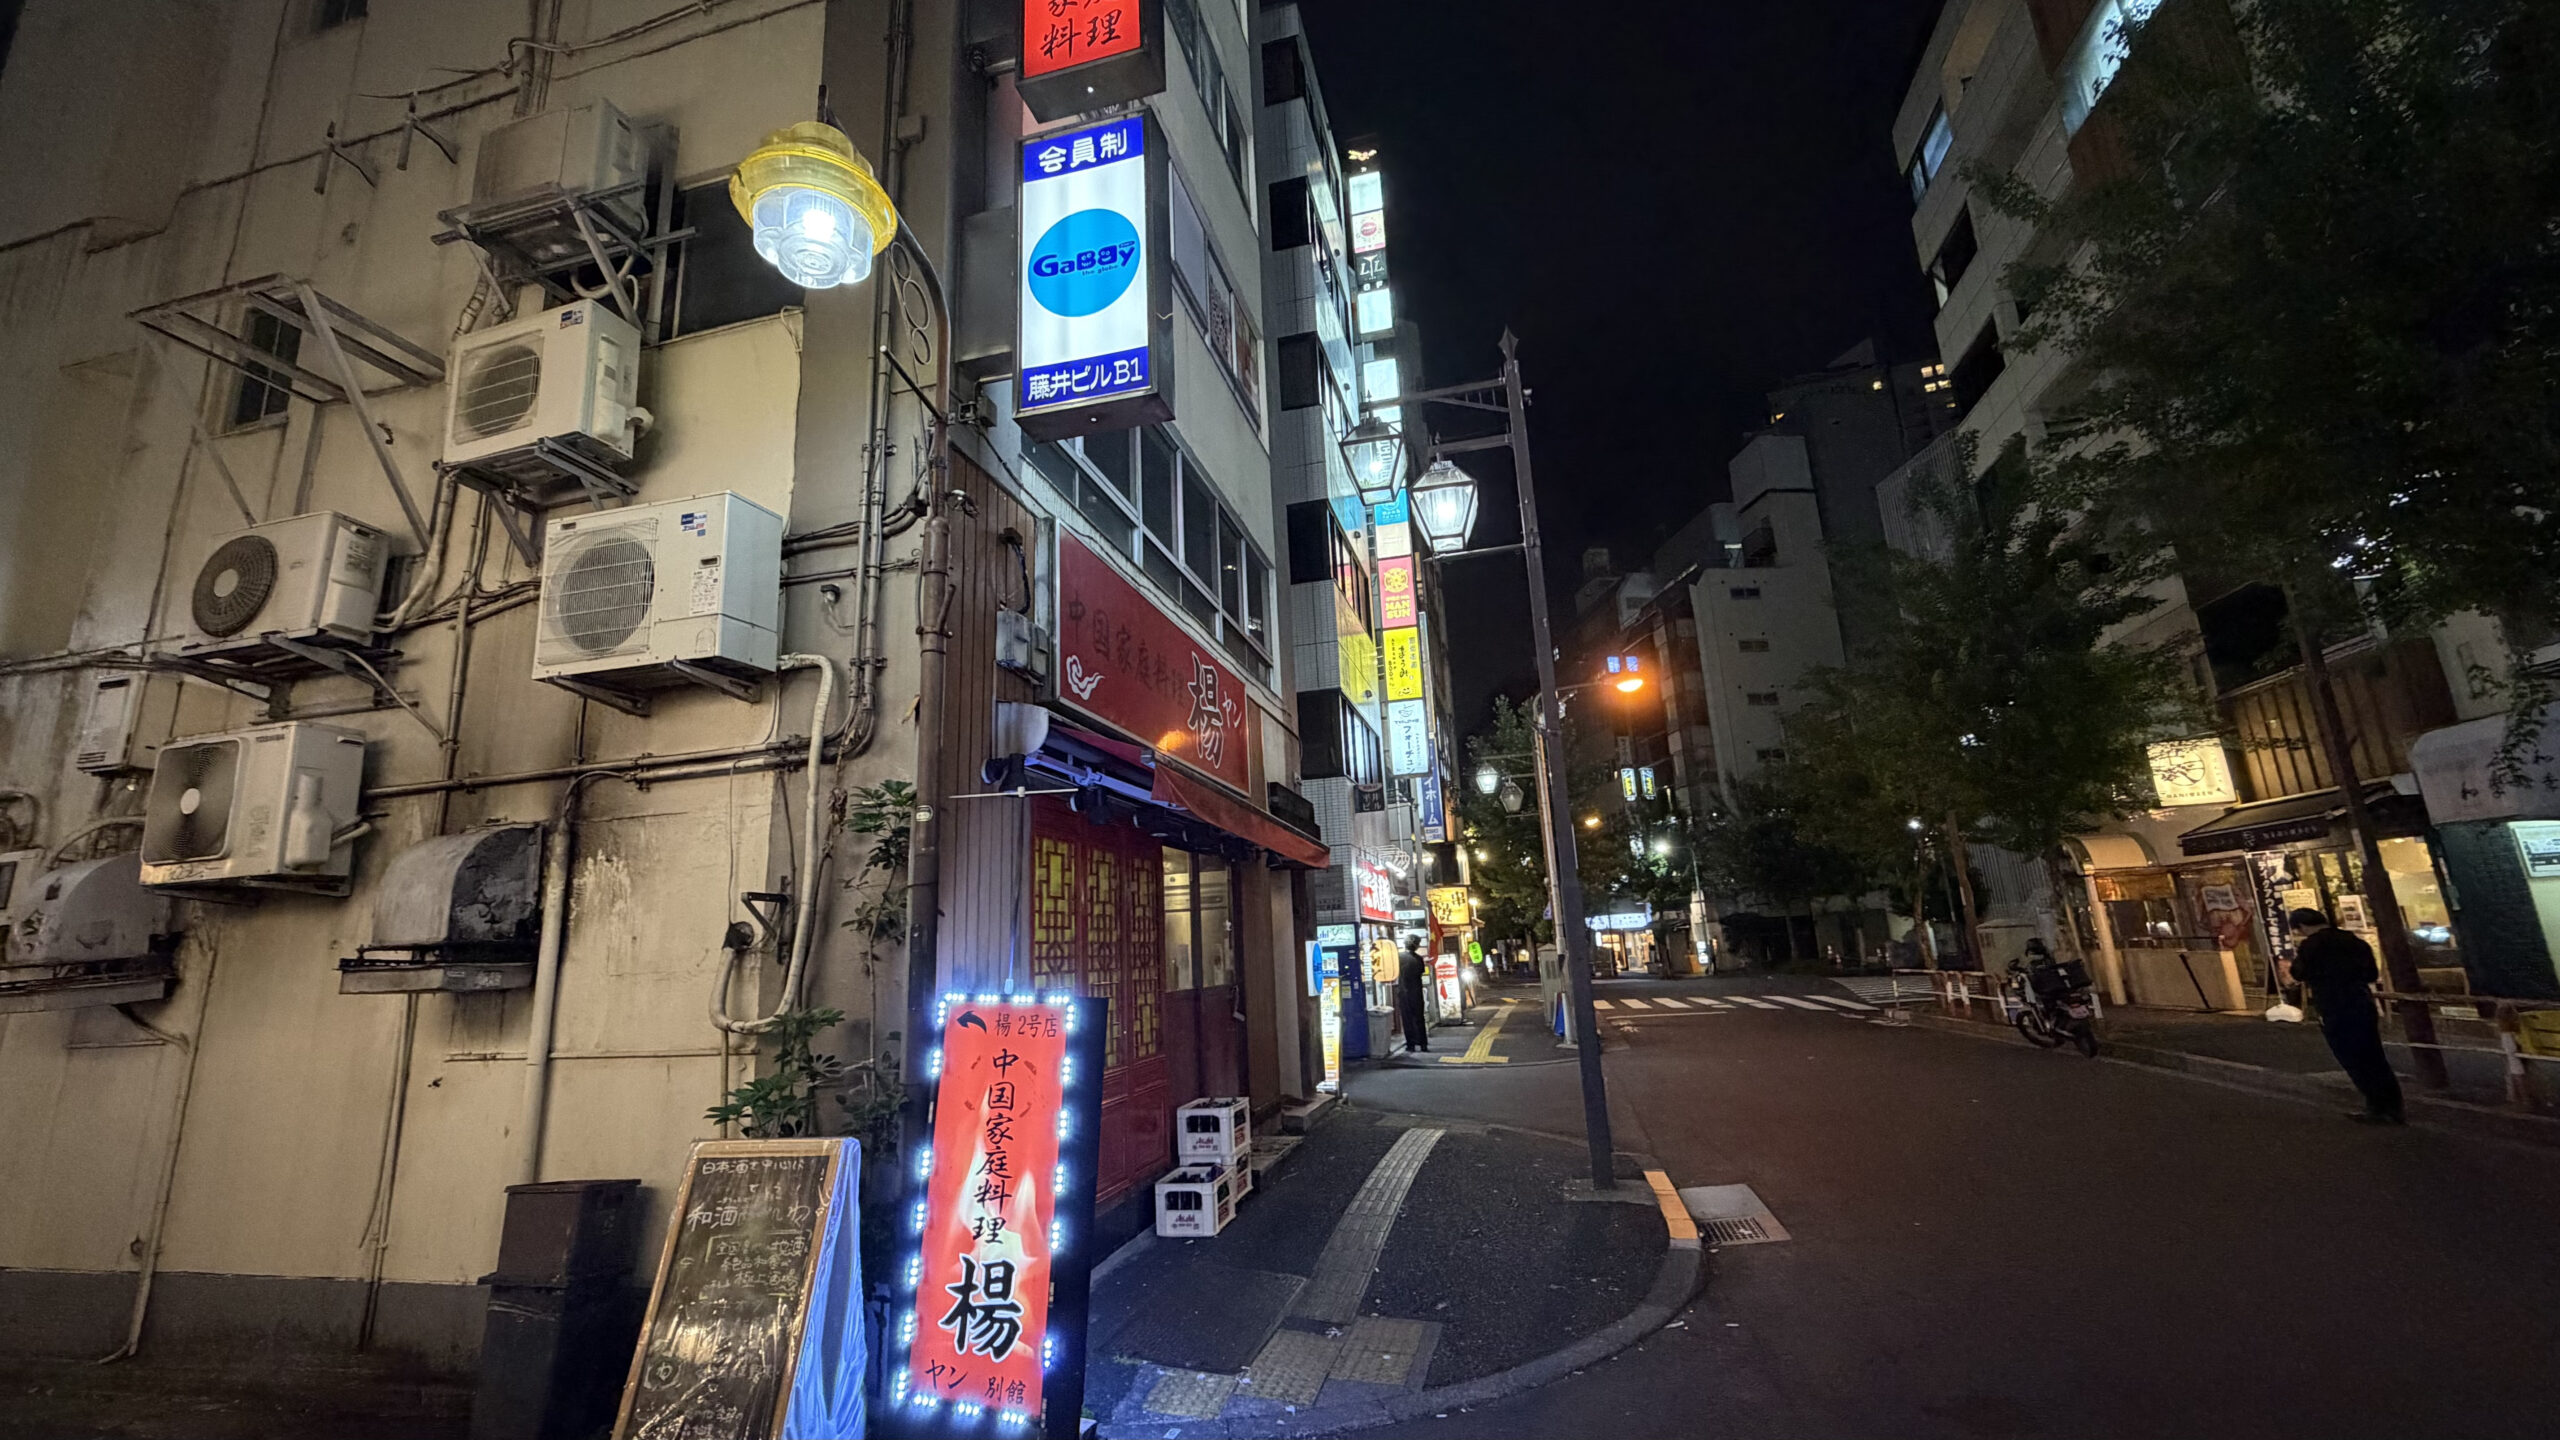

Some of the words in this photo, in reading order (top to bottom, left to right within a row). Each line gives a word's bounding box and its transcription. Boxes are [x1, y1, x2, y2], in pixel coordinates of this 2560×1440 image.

[1040, 8, 1122, 60] 料理
[1038, 128, 1128, 174] 会員制
[1187, 650, 1223, 770] 楊
[1017, 1012, 1059, 1039] 2号店
[971, 1048, 1020, 1246] 中国家庭料理
[938, 1254, 1025, 1363] 楊
[925, 1359, 968, 1391] ヤン
[984, 1376, 1026, 1406] 別館
